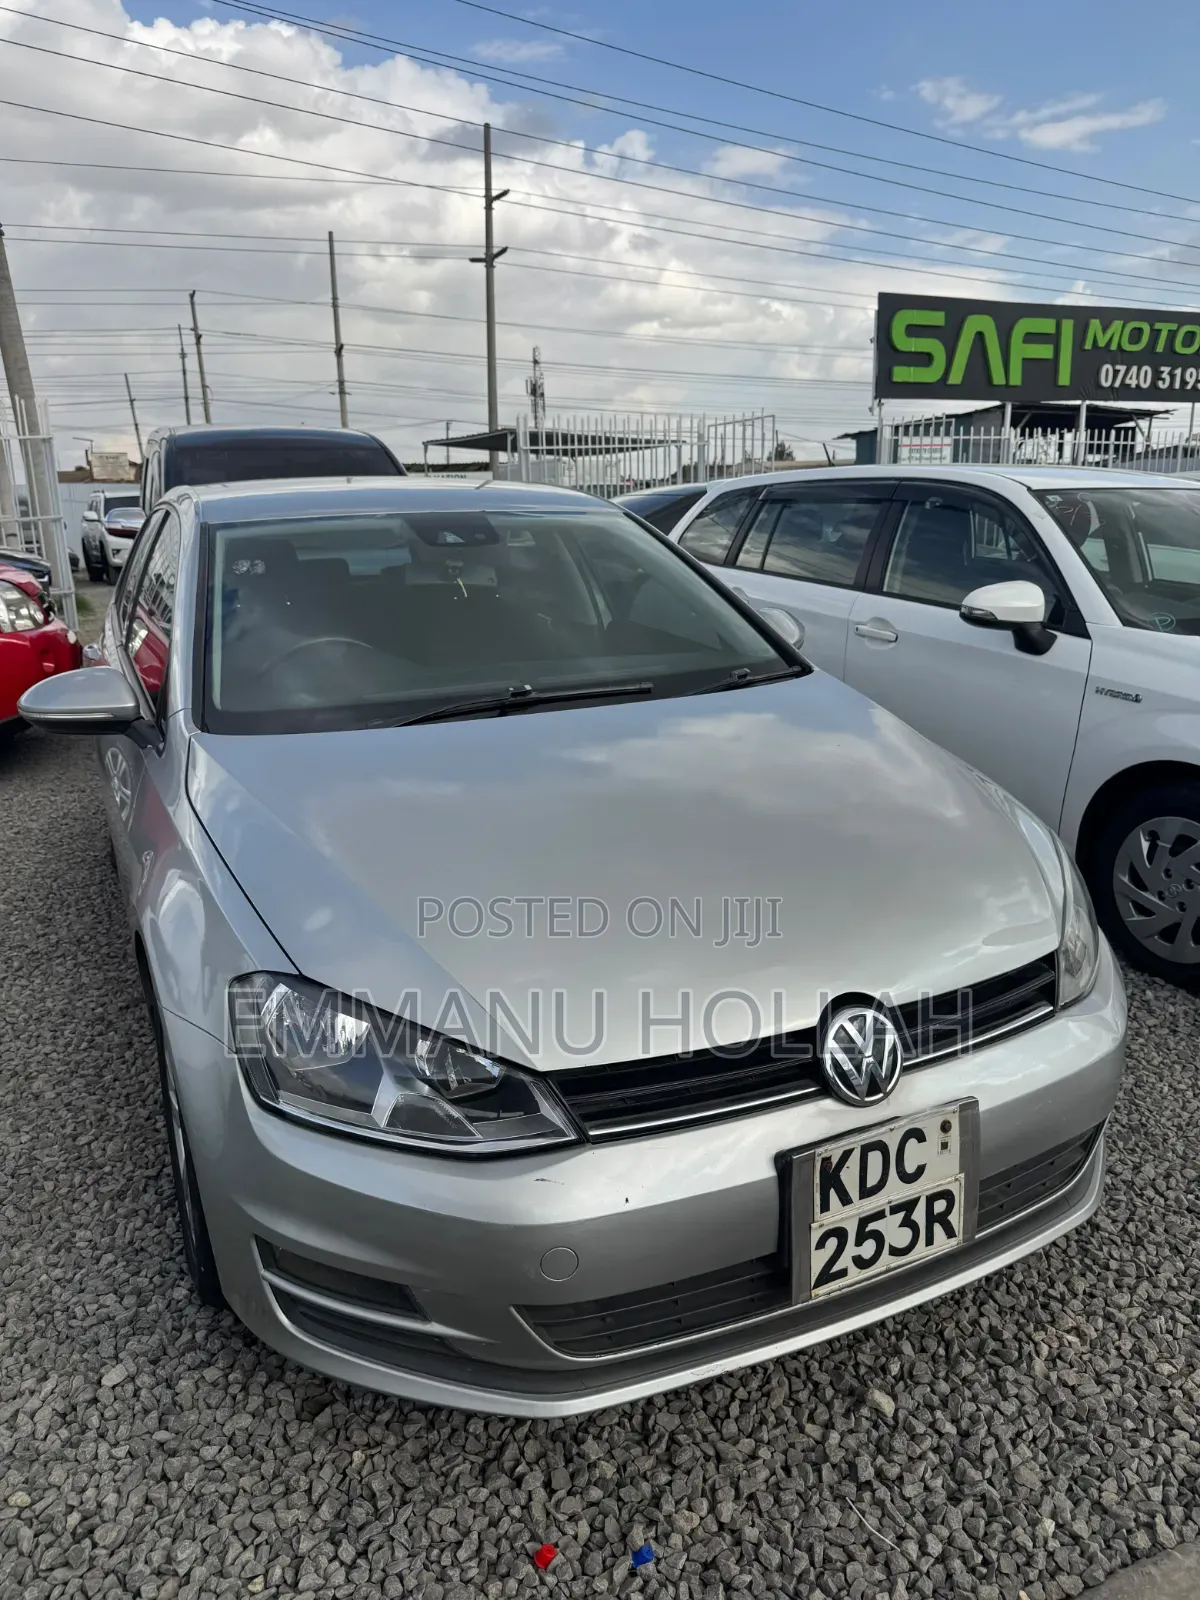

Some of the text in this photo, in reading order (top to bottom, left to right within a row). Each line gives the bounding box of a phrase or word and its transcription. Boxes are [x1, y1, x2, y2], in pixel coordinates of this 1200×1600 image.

[890, 309, 1074, 386] SAFI
[1100, 363, 1200, 390] 0740 319
[819, 1127, 928, 1214] KDC
[812, 1188, 958, 1291] 253R
